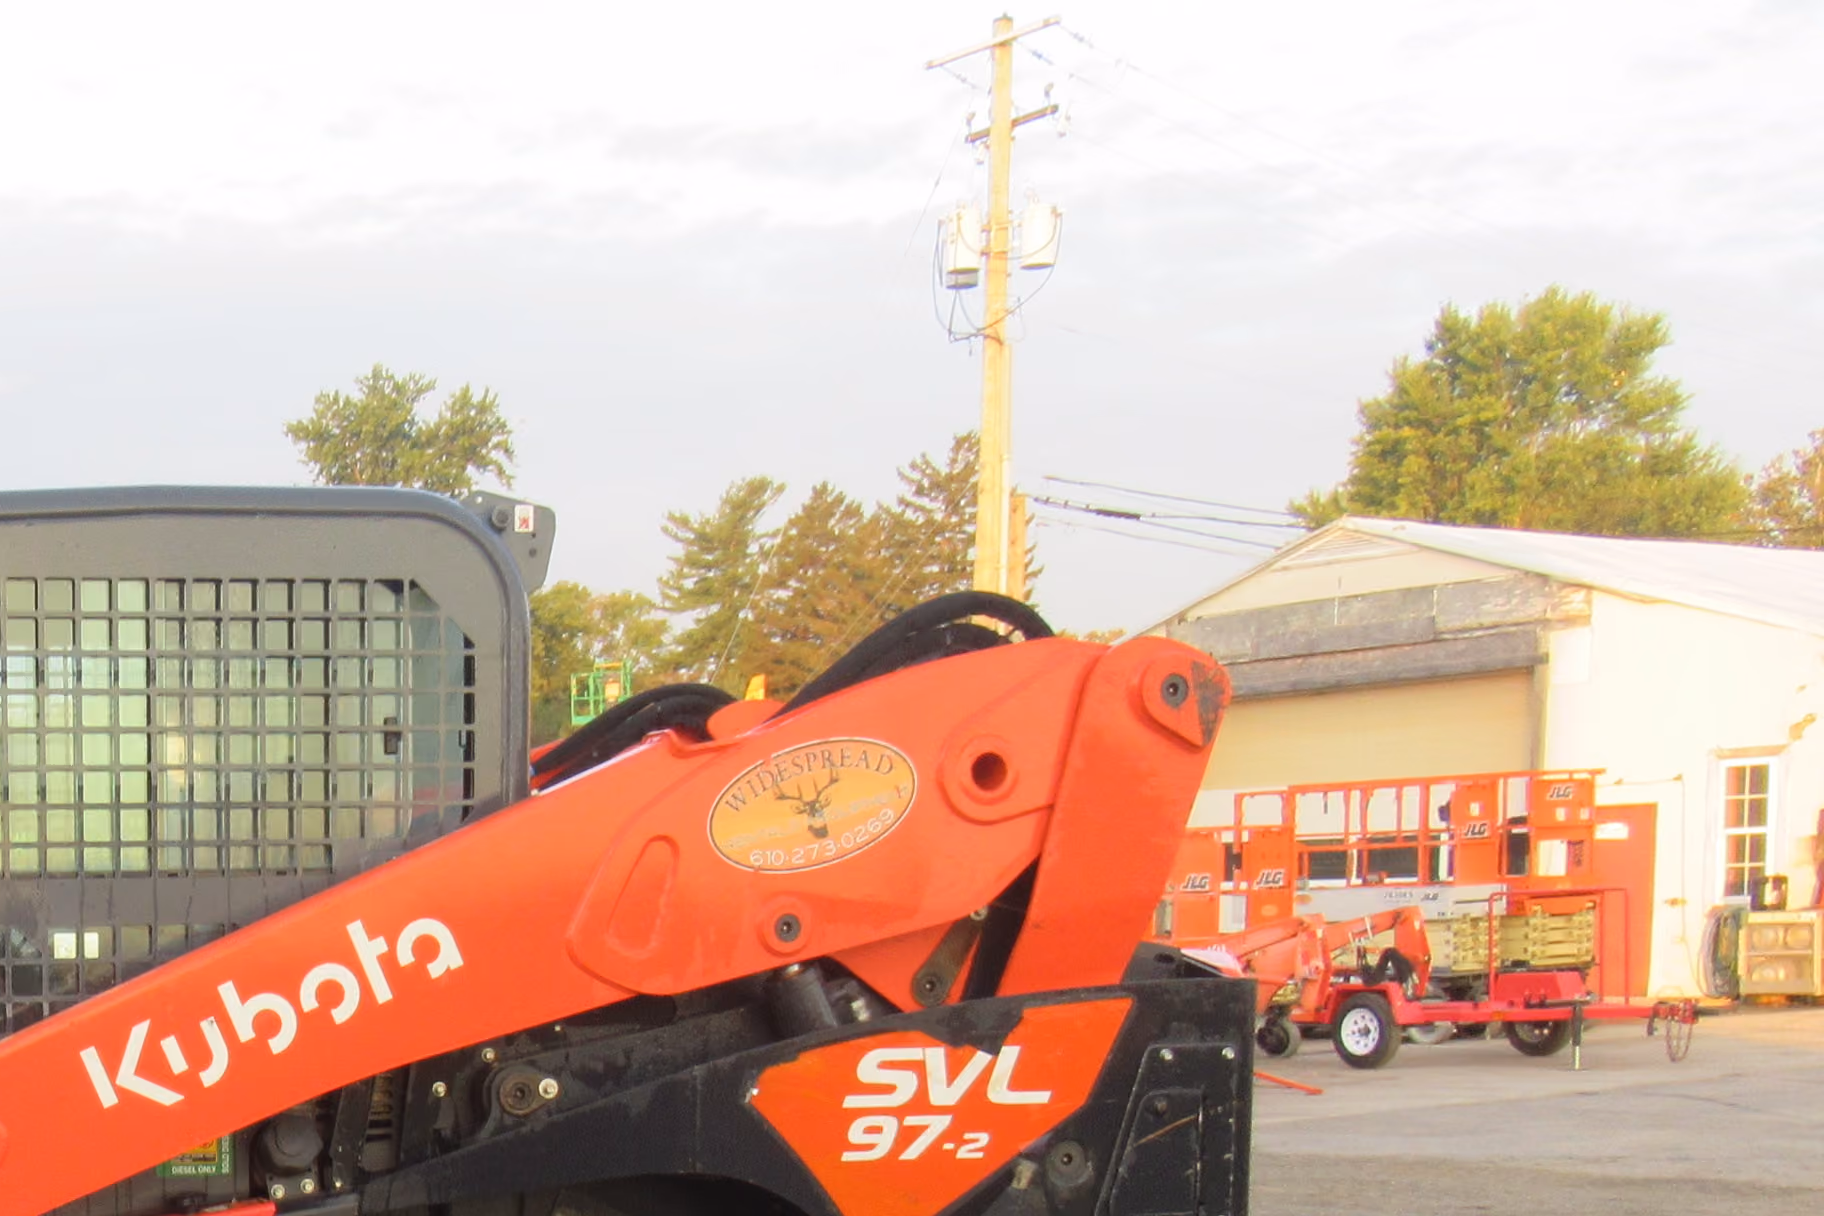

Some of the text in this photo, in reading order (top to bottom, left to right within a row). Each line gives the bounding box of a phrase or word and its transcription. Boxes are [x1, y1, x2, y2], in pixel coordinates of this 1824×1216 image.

[725, 748, 894, 812] WIDESPREAD
[1549, 786, 1573, 799] JLG
[1465, 823, 1488, 837] JLG
[1181, 874, 1210, 890] JLG
[1256, 870, 1284, 886] JLG
[79, 918, 464, 1110] Kubota
[842, 1045, 1052, 1109] SVL
[841, 1115, 990, 1162] 97-2
[171, 1164, 217, 1175] DIESEL ONLY
